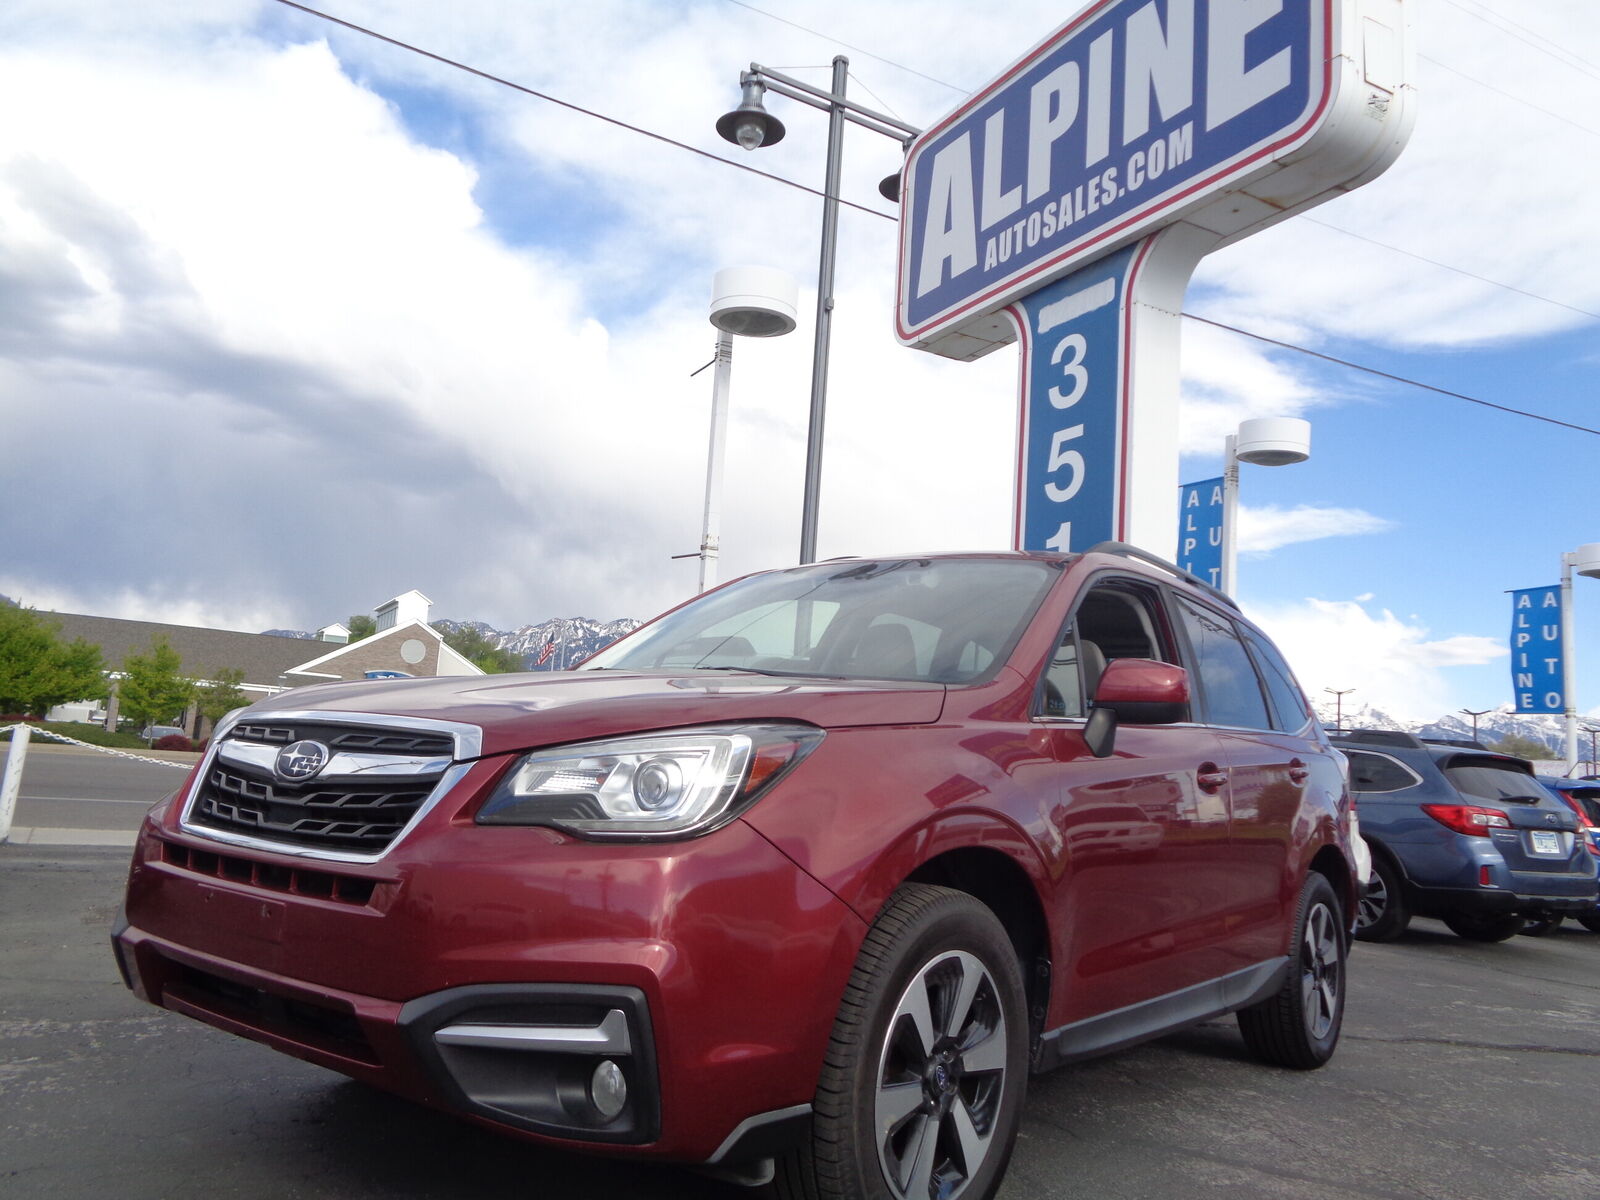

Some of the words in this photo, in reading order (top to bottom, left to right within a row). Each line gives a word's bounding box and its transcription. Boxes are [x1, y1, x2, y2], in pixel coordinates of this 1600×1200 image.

[916, 0, 1292, 300] ALPINE
[984, 119, 1193, 273] AUTOSALES.COM
[1517, 593, 1534, 709] ALPINE
[1542, 591, 1561, 709] AUTO
